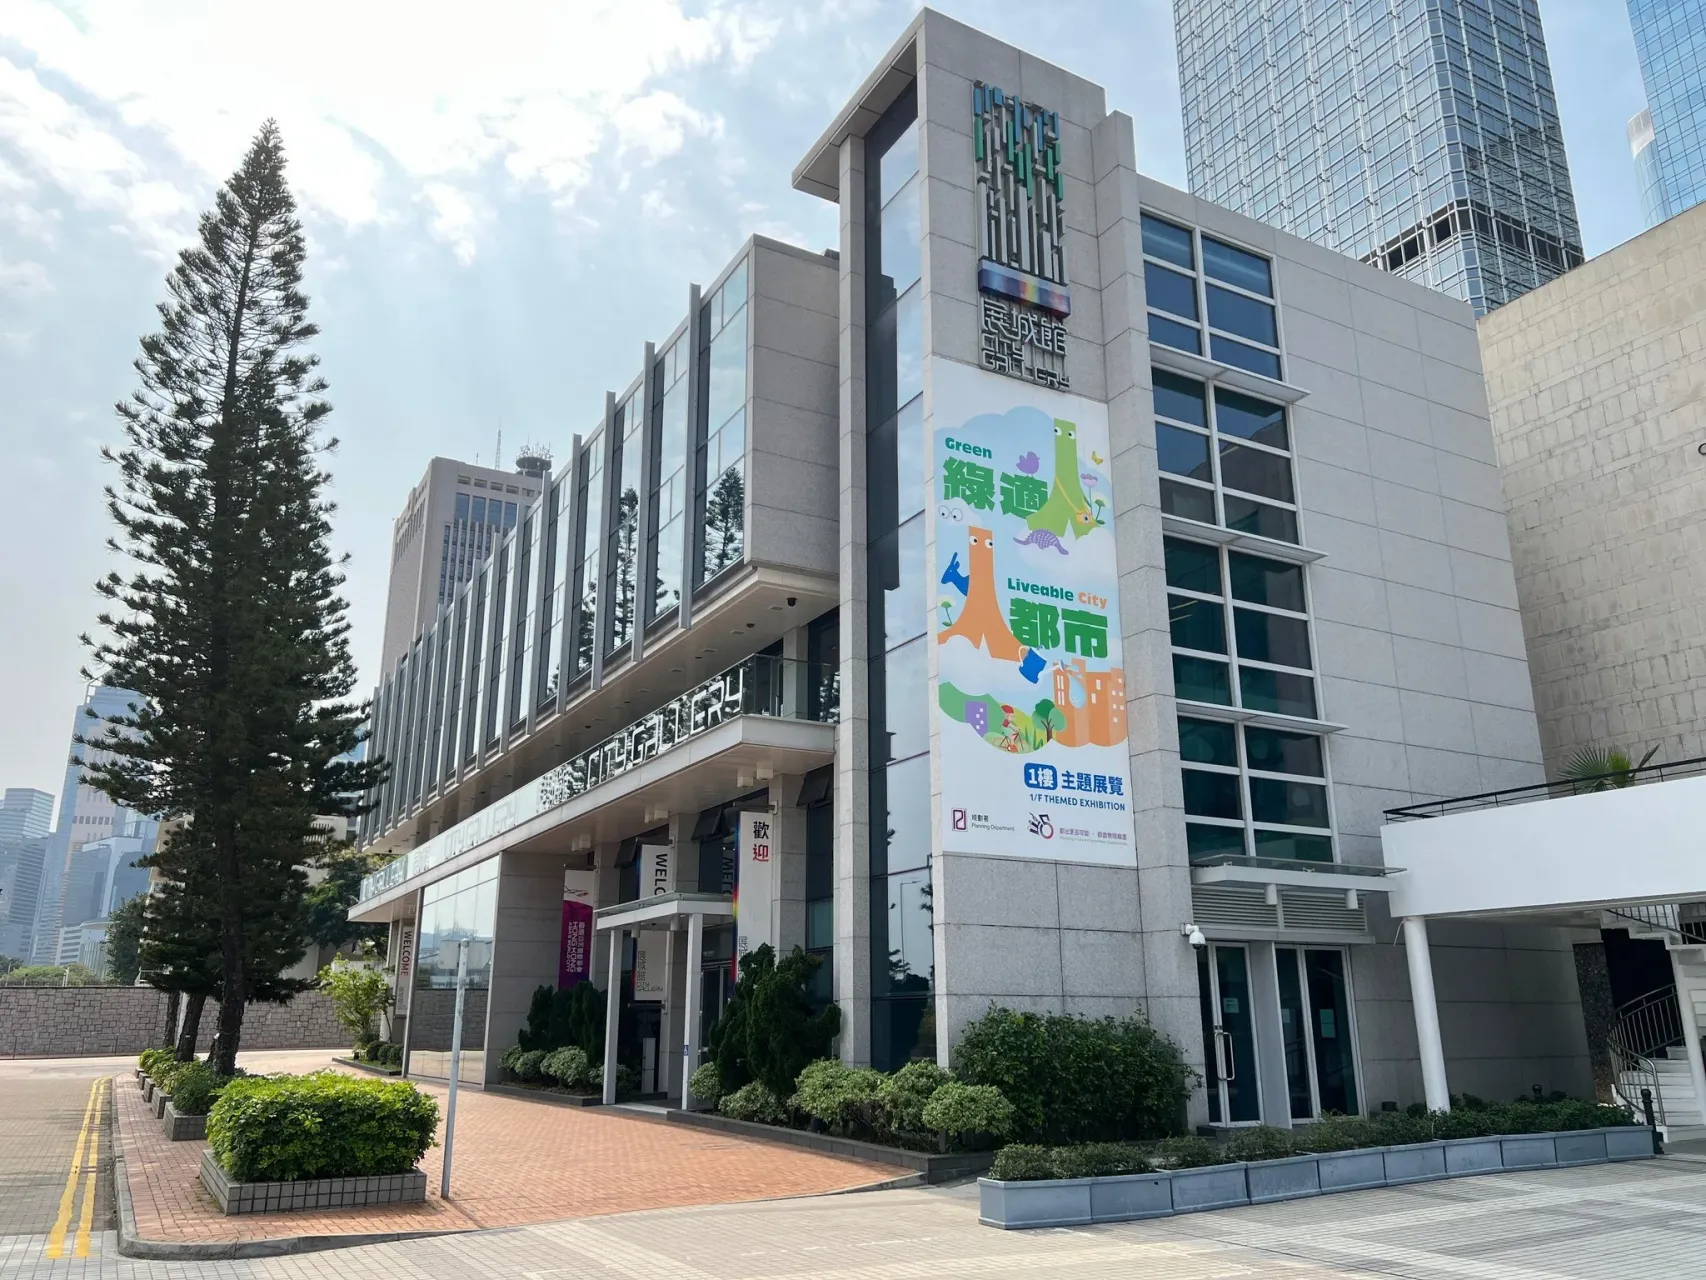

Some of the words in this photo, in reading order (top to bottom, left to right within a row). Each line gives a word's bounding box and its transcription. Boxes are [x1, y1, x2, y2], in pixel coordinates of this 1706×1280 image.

[982, 333, 1024, 360] CITY
[982, 349, 1071, 389] GALLERY
[945, 437, 992, 459] Green
[1007, 577, 1074, 601] Liveable
[1078, 592, 1107, 609] City
[1009, 597, 1108, 658] 都市
[630, 667, 744, 765] GALLERY
[1028, 767, 1053, 788] 1樓
[1061, 770, 1124, 796] 主題展覽
[1029, 793, 1043, 802] 1/F
[1044, 794, 1078, 806] THEMED
[1079, 798, 1125, 811] EXHIBITION
[752, 820, 770, 862] 歡迎
[971, 822, 990, 831] Planning
[990, 824, 1015, 832] Department
[400, 930, 412, 976] WELCOME
[570, 947, 578, 972] KONG
